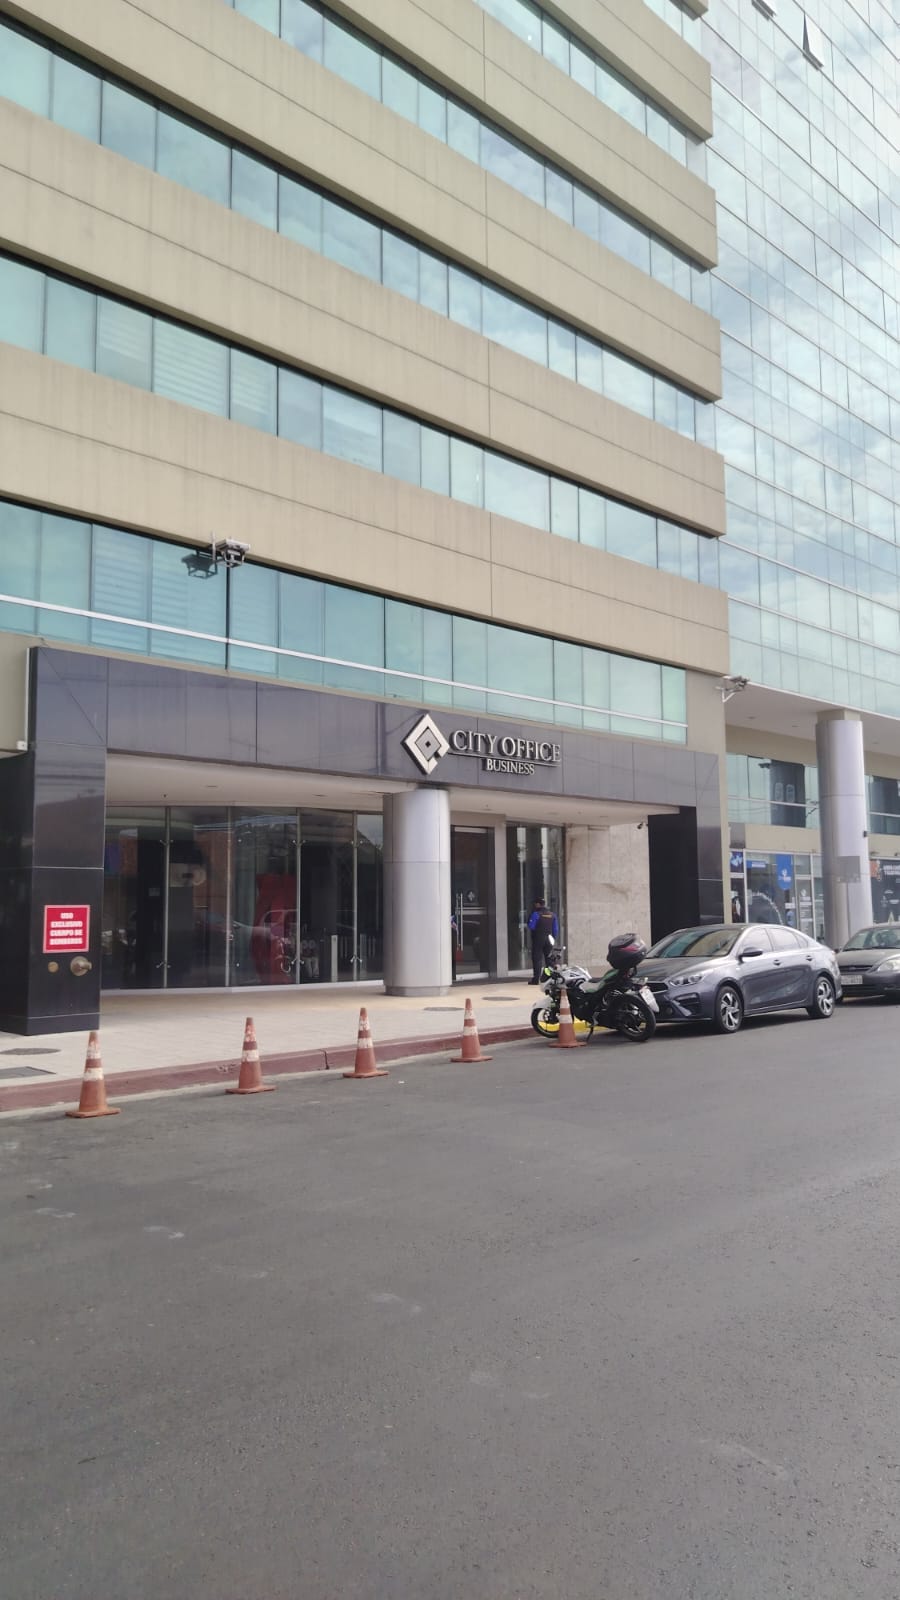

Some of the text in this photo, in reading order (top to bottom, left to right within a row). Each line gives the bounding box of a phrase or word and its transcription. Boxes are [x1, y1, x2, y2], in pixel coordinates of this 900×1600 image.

[452, 730, 561, 761] CITY OFFICE
[485, 758, 535, 774] BUSINESS
